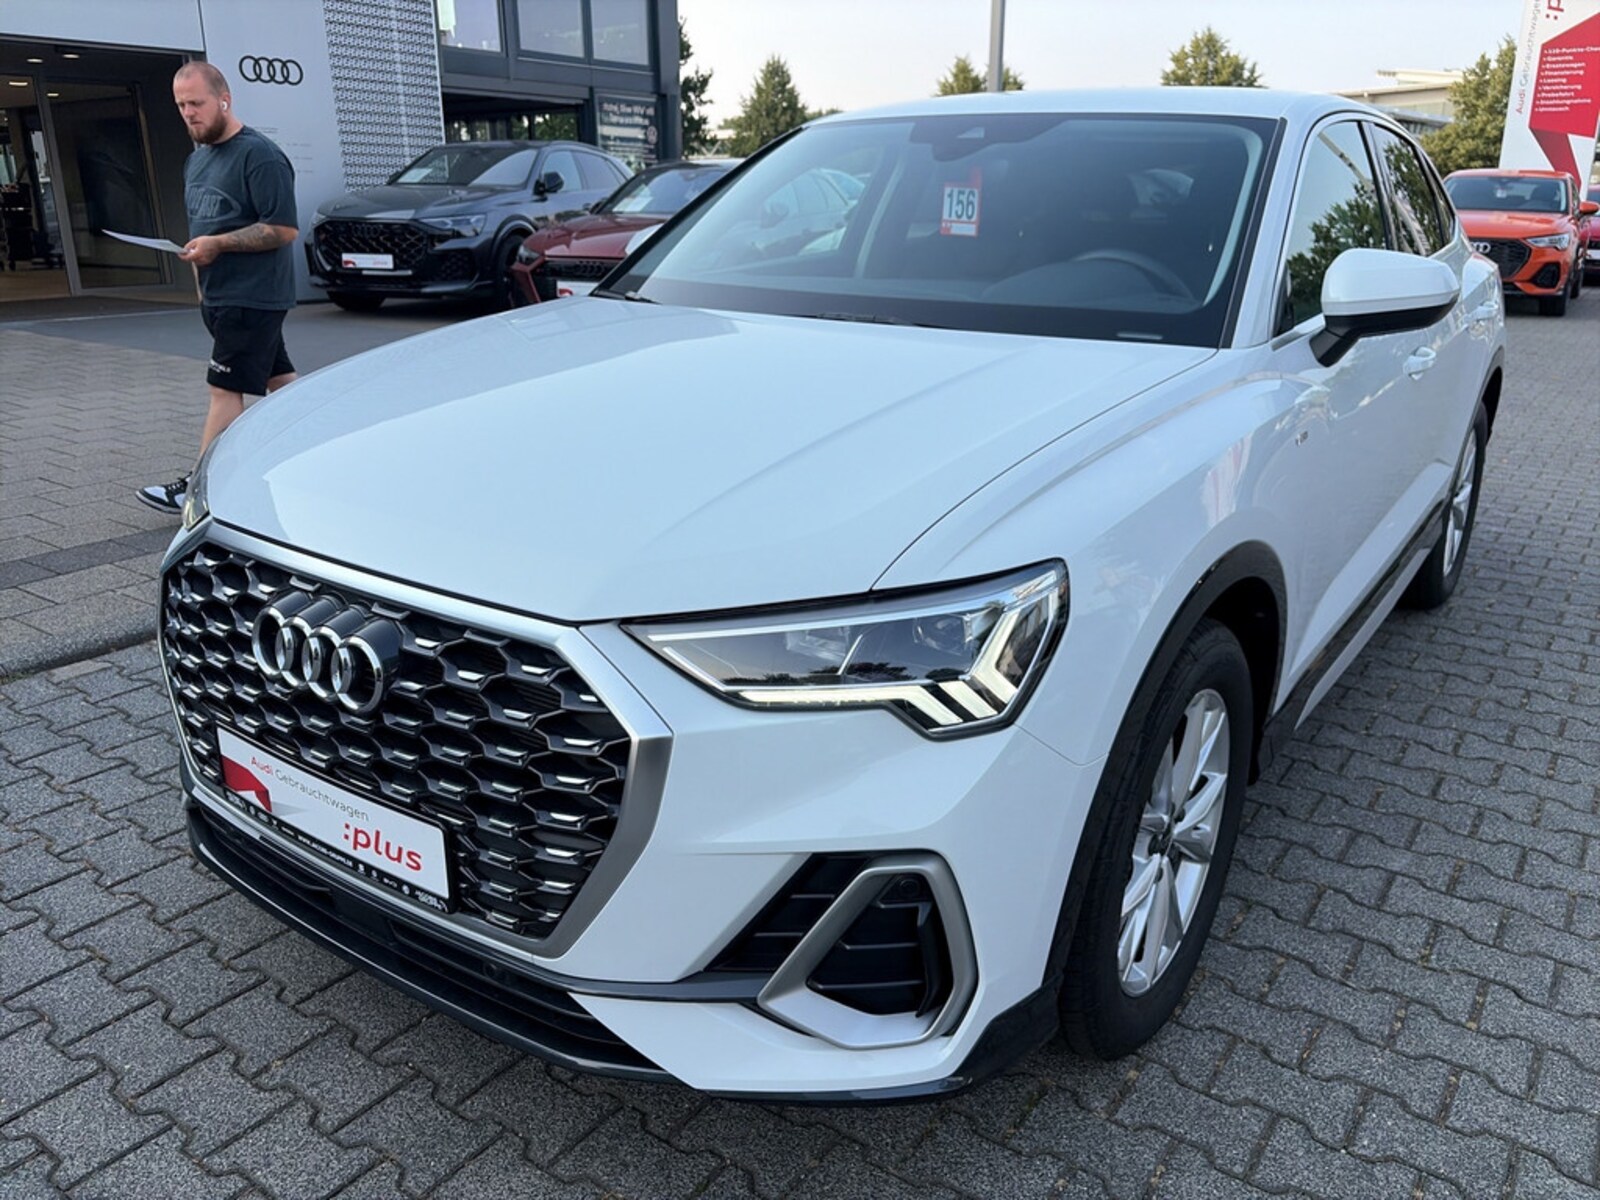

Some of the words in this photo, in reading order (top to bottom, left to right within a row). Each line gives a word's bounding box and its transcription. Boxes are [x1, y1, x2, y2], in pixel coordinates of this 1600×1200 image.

[1519, 0, 1541, 87] Gebrauchtwage
[1515, 89, 1526, 114] Audi
[946, 189, 976, 220] 156
[251, 756, 274, 776] Audi
[275, 769, 369, 822] Gebrauchtwagen
[343, 822, 422, 872] :plus
